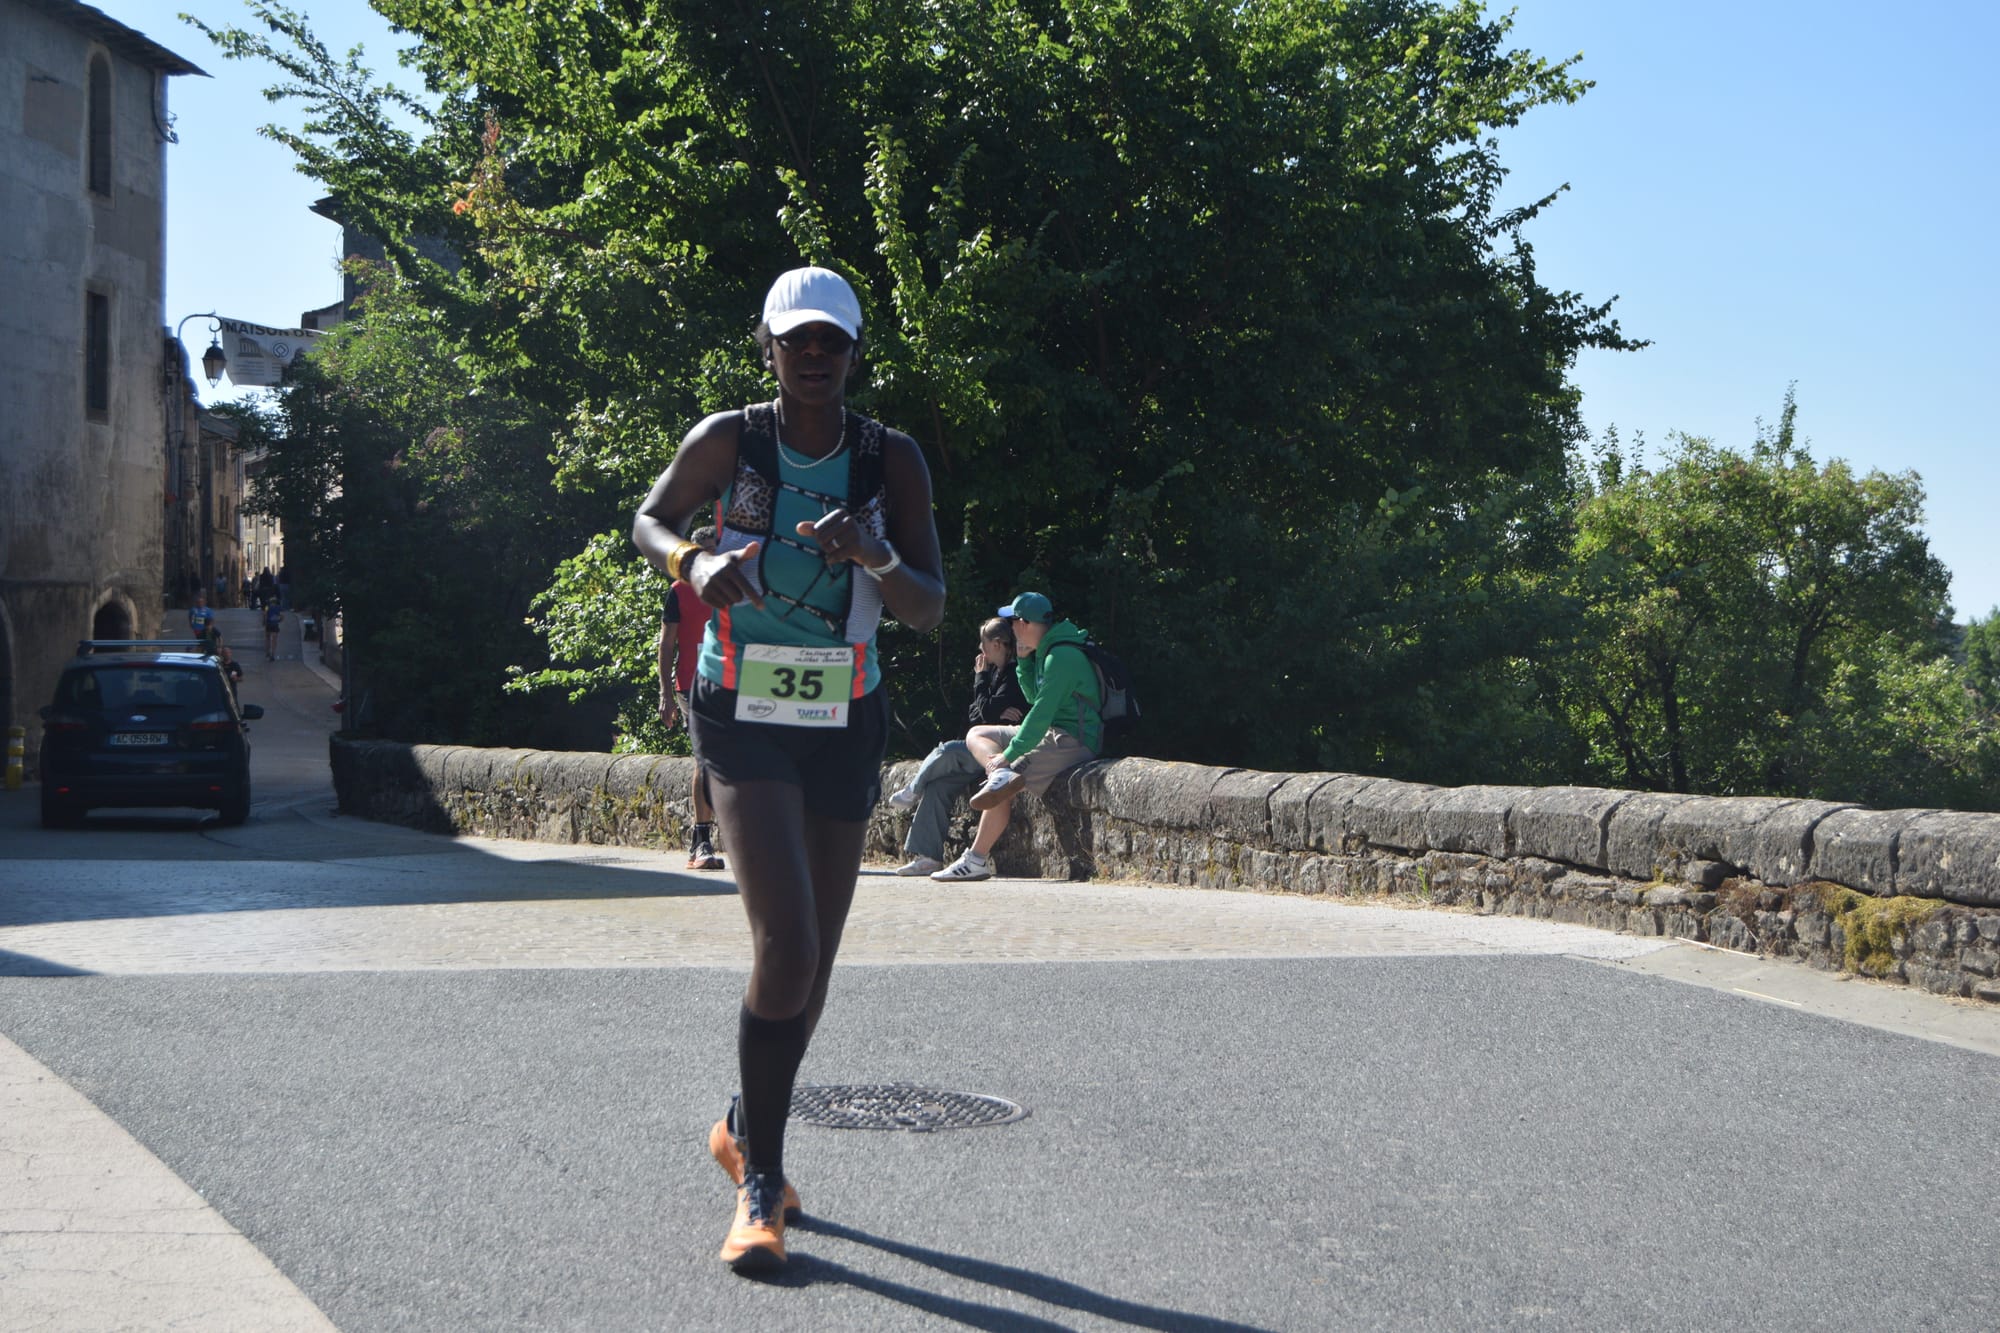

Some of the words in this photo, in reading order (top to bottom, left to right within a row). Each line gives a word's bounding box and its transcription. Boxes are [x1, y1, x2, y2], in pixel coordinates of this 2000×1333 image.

[225, 321, 289, 337] MAISON
[294, 329, 314, 338] DE
[770, 667, 824, 700] 35
